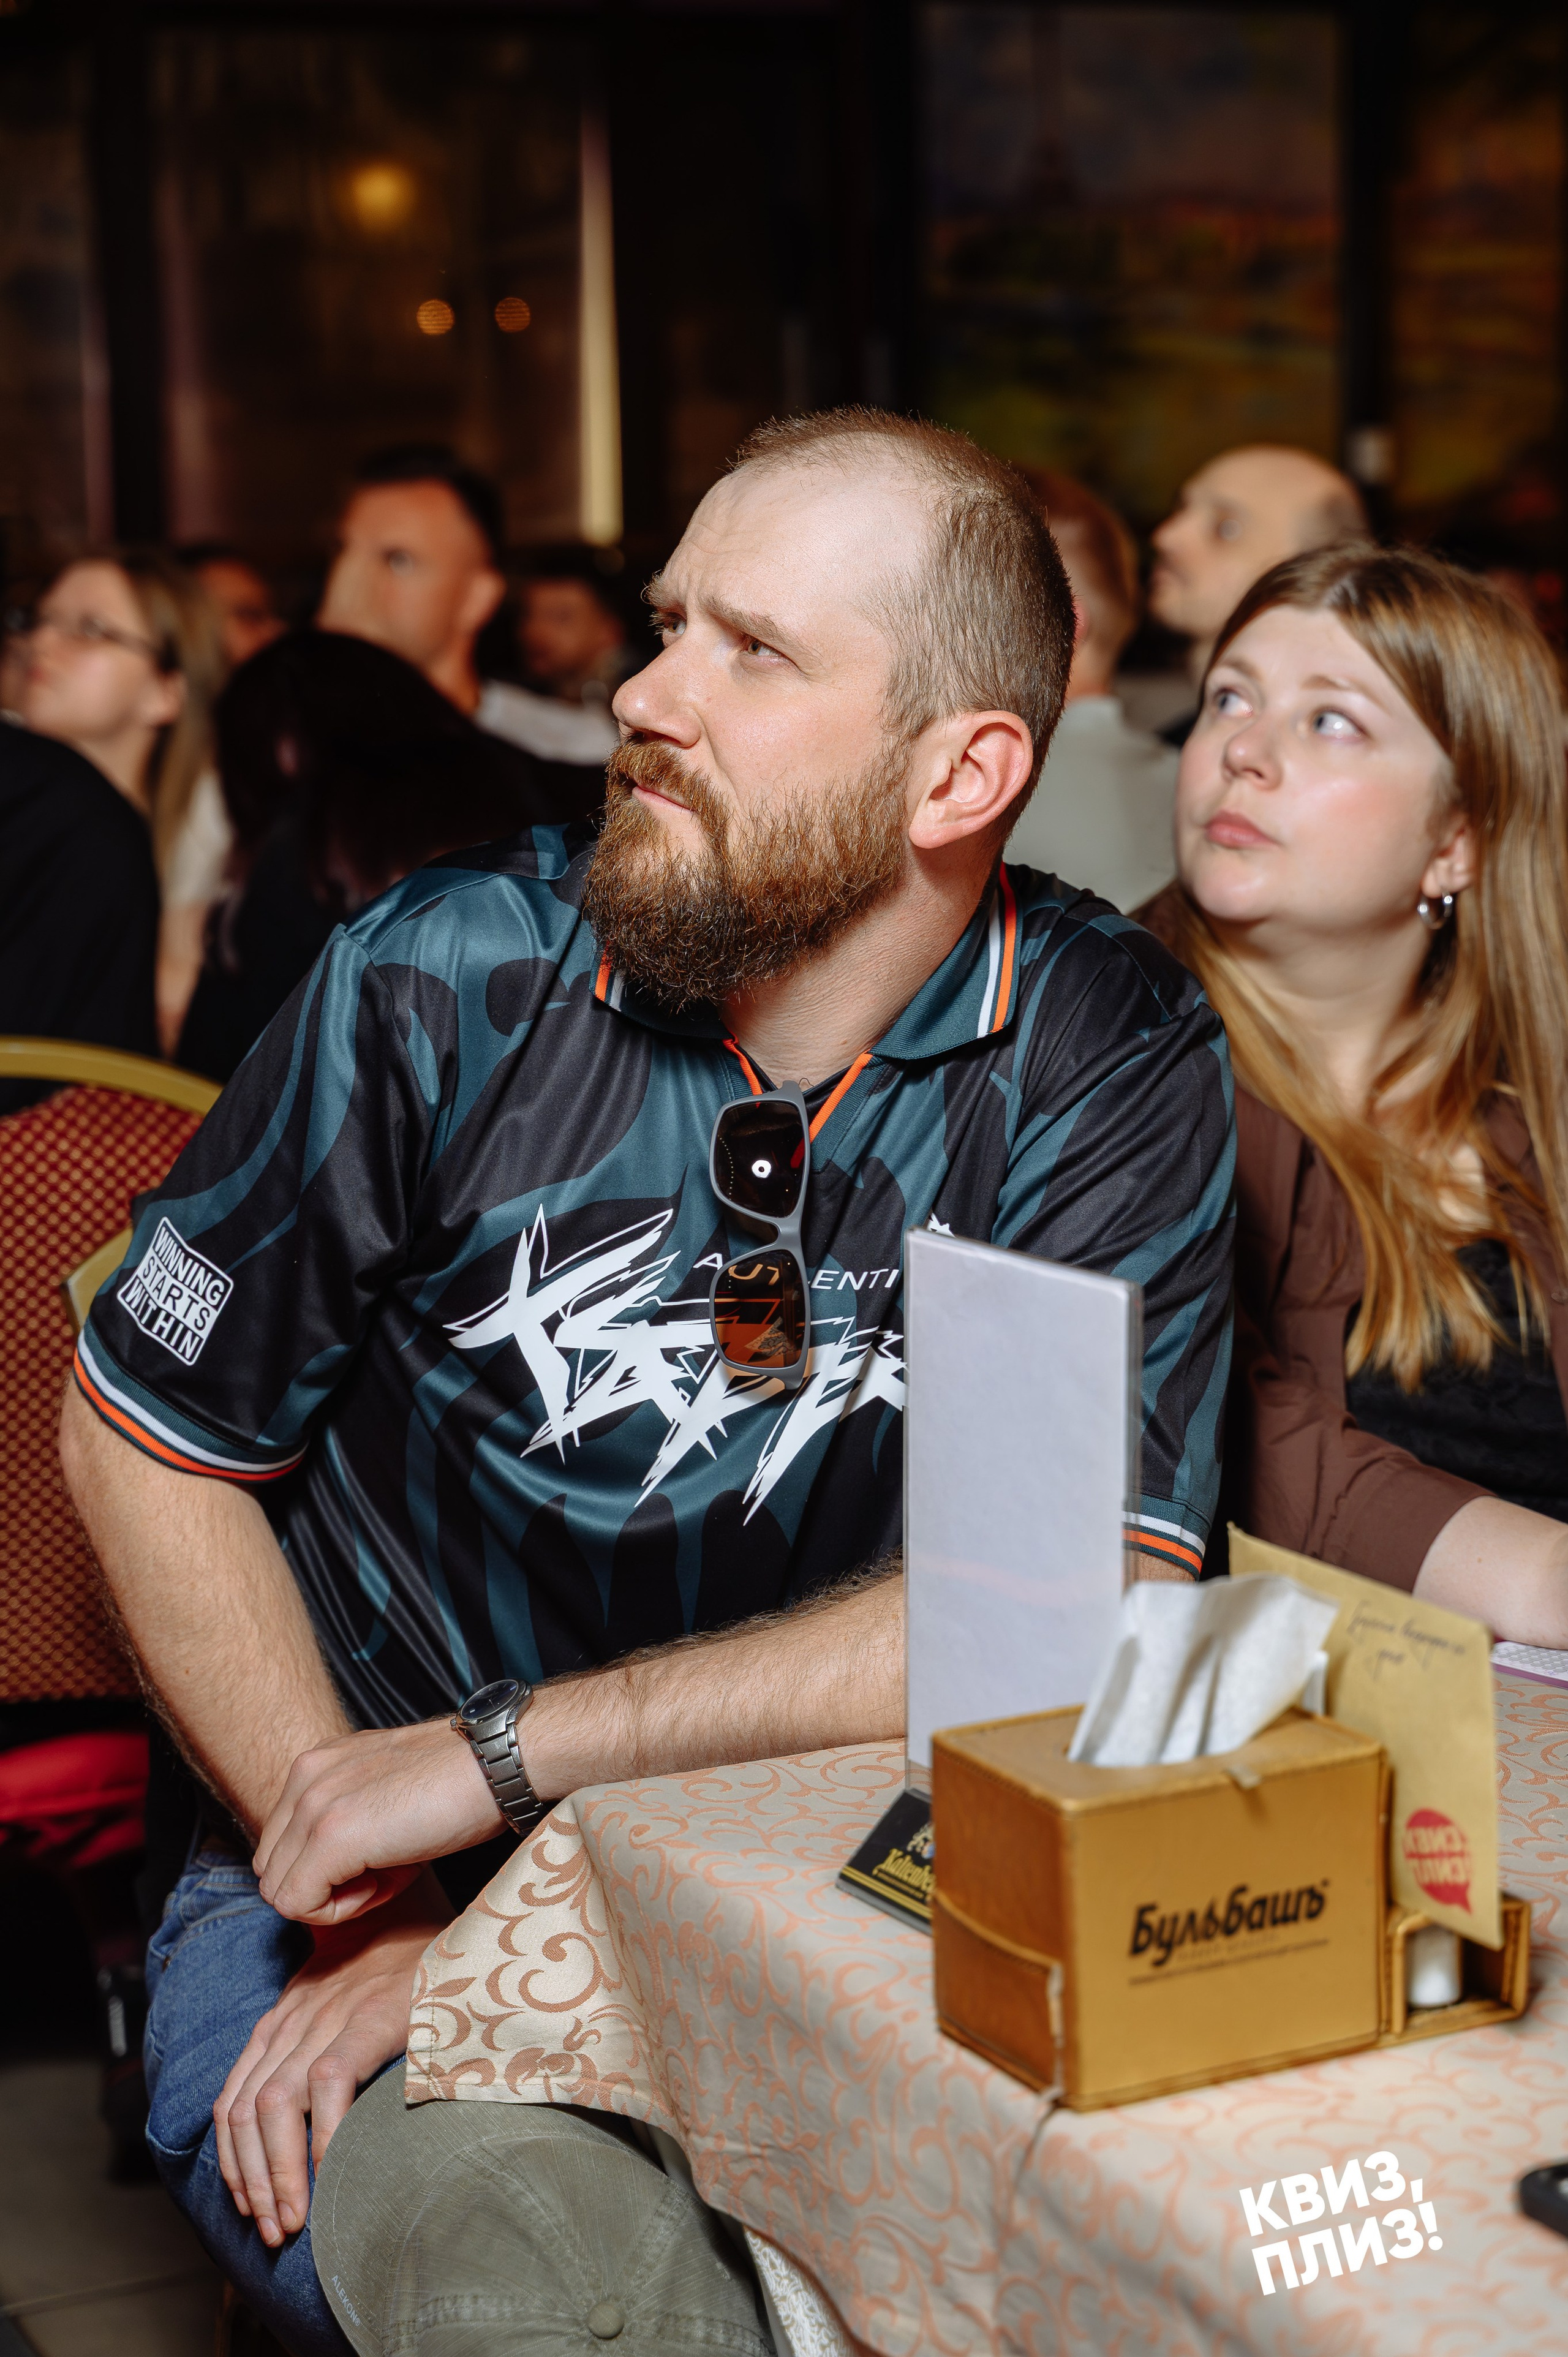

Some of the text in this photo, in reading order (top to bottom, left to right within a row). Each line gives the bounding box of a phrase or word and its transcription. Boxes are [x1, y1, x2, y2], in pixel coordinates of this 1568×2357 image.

[142, 1257, 211, 1332] STARTS
[154, 1226, 225, 1306] WINNING
[693, 1253, 900, 1291] AUTENTI
[124, 1278, 200, 1360] WITHIN
[1128, 1881, 1327, 1969] Бульбашъ
